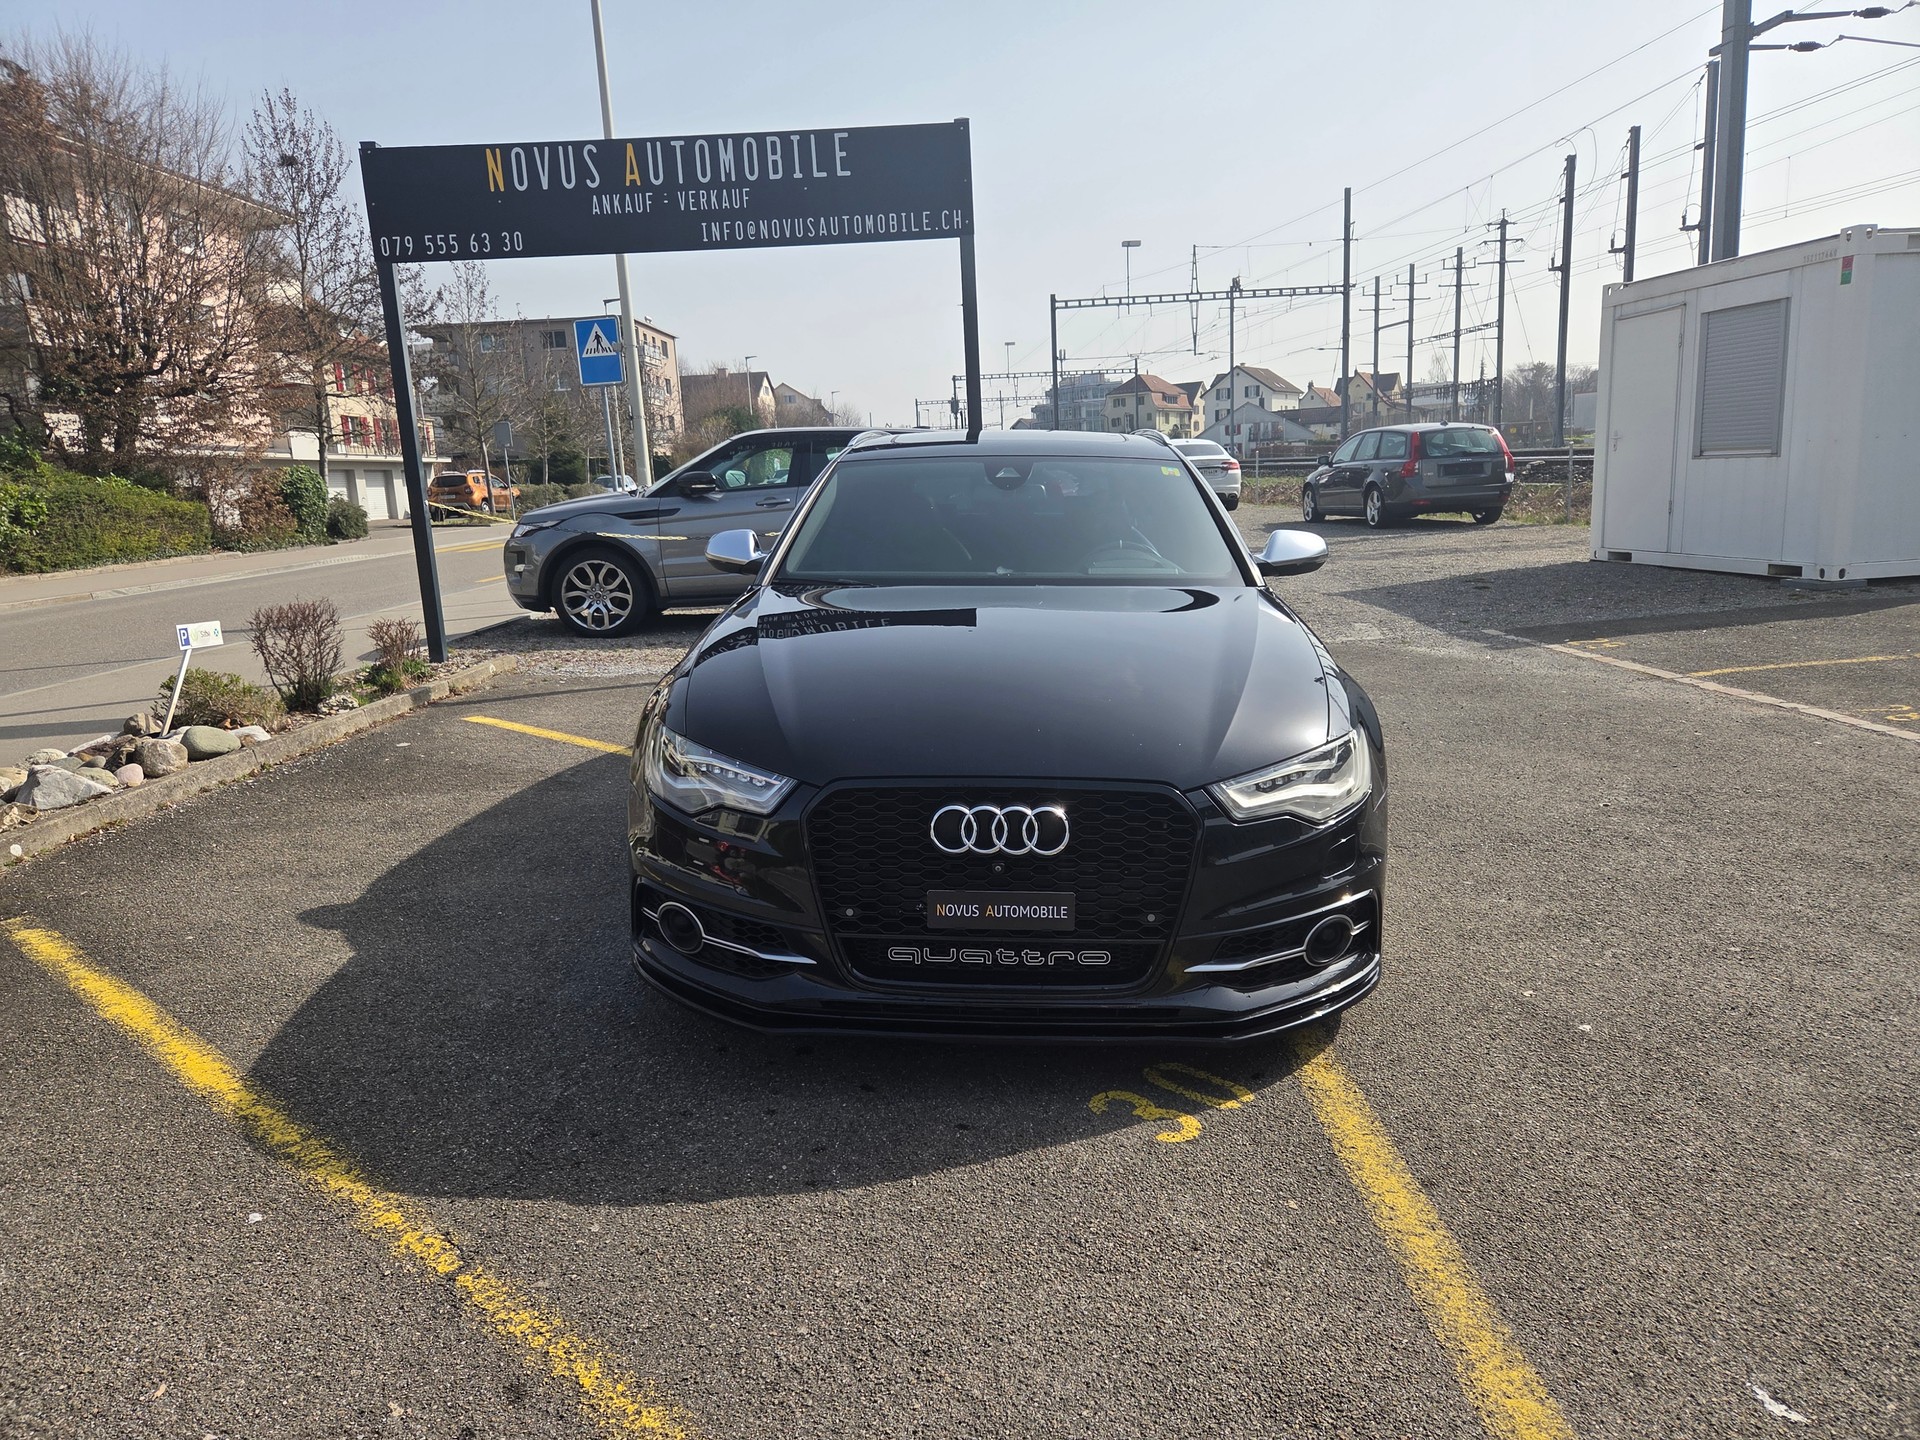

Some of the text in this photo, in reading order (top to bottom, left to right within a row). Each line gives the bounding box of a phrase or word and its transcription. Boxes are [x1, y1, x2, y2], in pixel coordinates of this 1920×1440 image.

[485, 132, 851, 193] NOVUS AUTOMOBILE
[592, 192, 654, 216] ANKAUF
[677, 188, 751, 212] VERKAUF
[701, 209, 963, 243] INFO@NOVUSAUTOMOBILE.CH
[380, 230, 524, 258] 079 555 63 30
[935, 903, 1068, 919] NOVUS AUTOMOBILE
[887, 946, 1112, 966] quattro
[1088, 1062, 1256, 1143] 30
